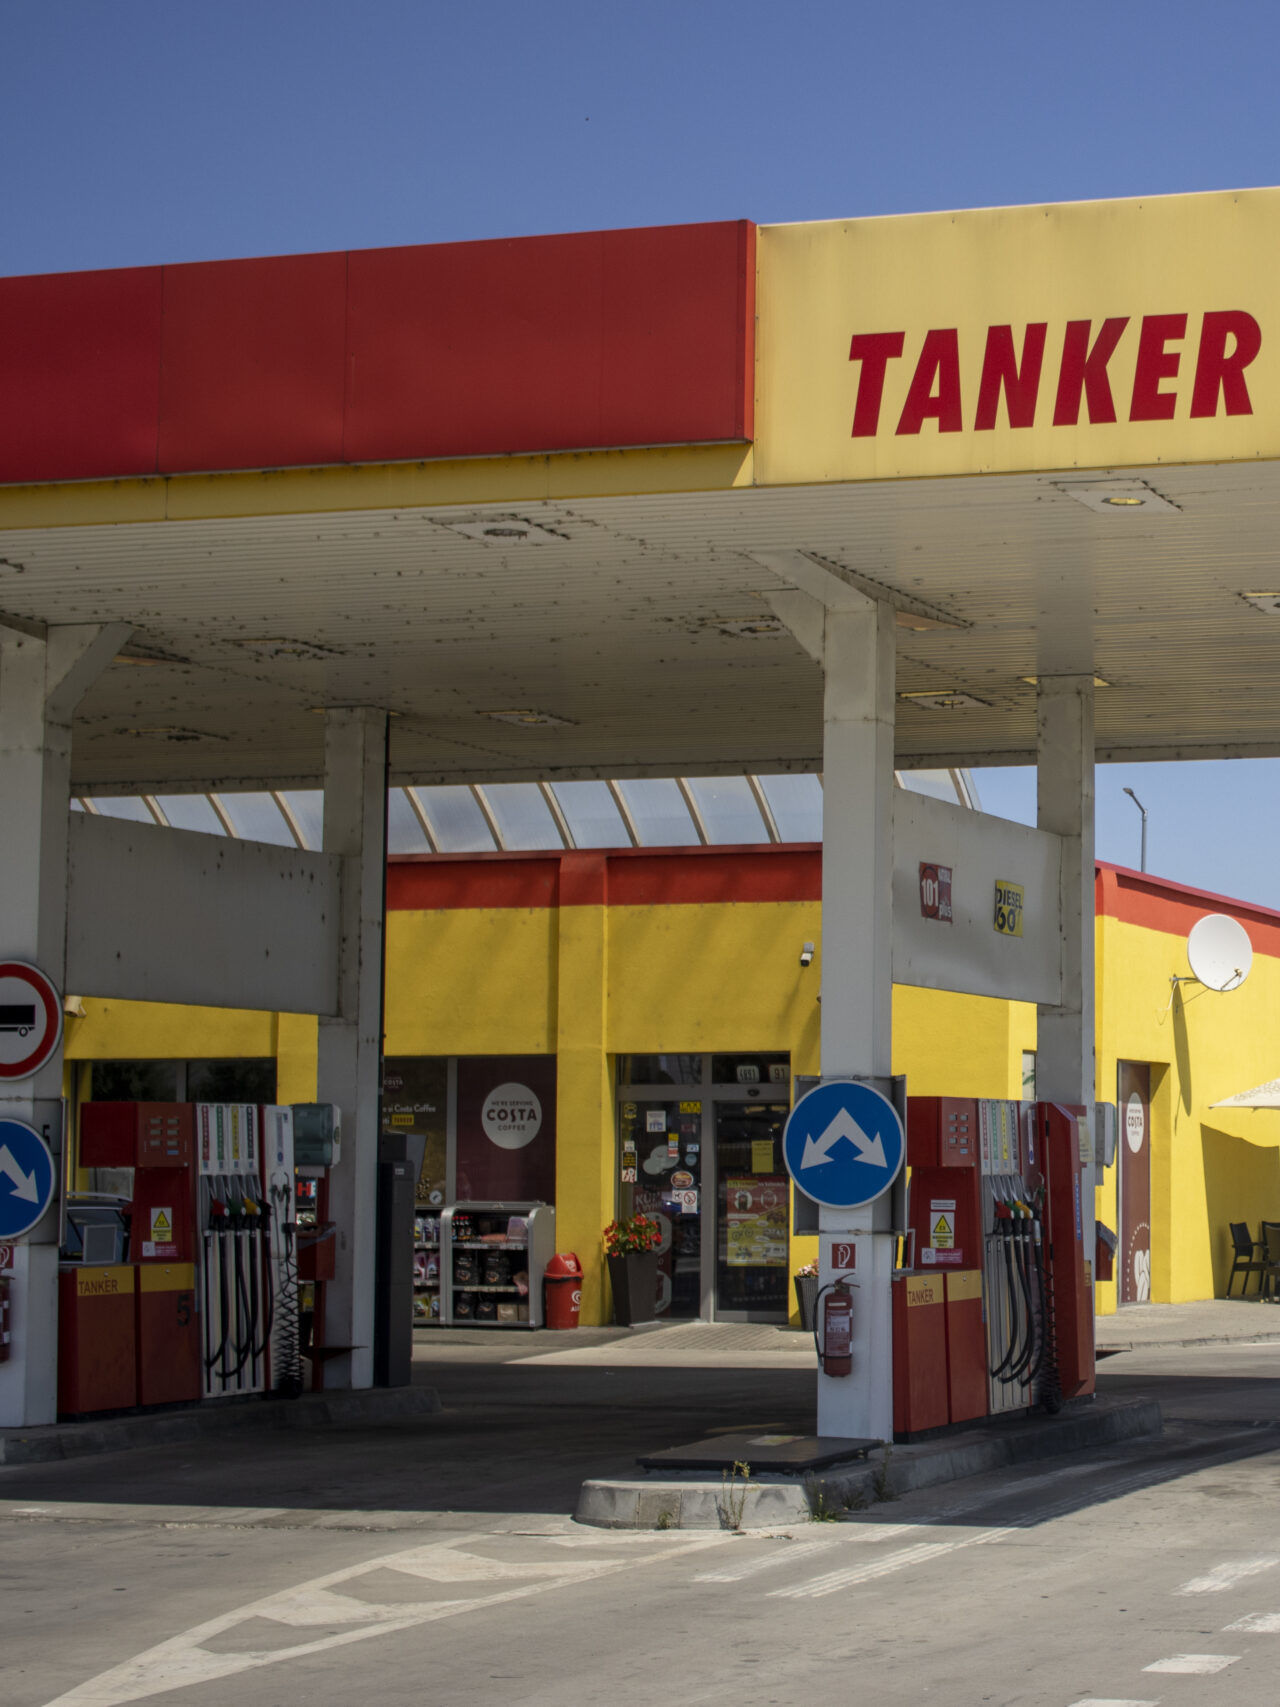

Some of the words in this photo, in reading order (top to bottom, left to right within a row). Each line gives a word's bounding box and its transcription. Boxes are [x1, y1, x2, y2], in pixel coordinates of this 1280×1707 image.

[849, 310, 1262, 437] TANKER
[921, 878, 938, 907] 101
[995, 888, 1022, 909] DIESEL
[487, 1108, 537, 1123] COSTA
[1128, 1116, 1143, 1128] COSTA
[78, 1279, 118, 1294] TANKER
[908, 1288, 934, 1305] TANKER
[177, 1294, 191, 1327] 5
